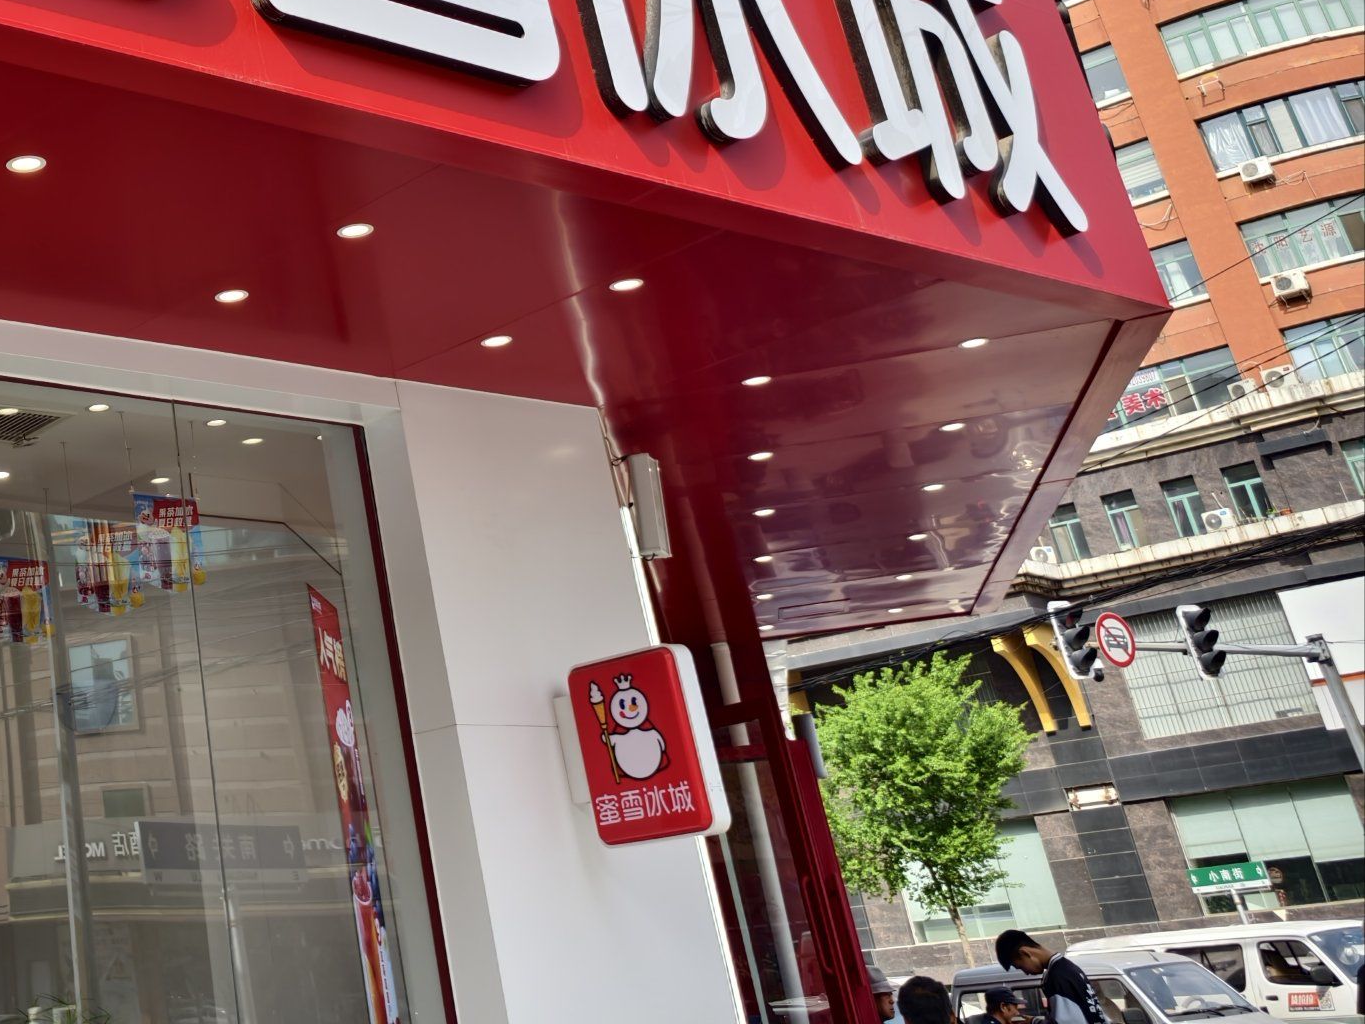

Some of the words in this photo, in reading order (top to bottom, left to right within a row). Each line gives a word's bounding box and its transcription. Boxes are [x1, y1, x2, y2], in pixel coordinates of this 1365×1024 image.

[1107, 387, 1168, 421] 美术
[596, 780, 696, 826] 蜜雪冰城
[1209, 867, 1244, 883] 小南街
